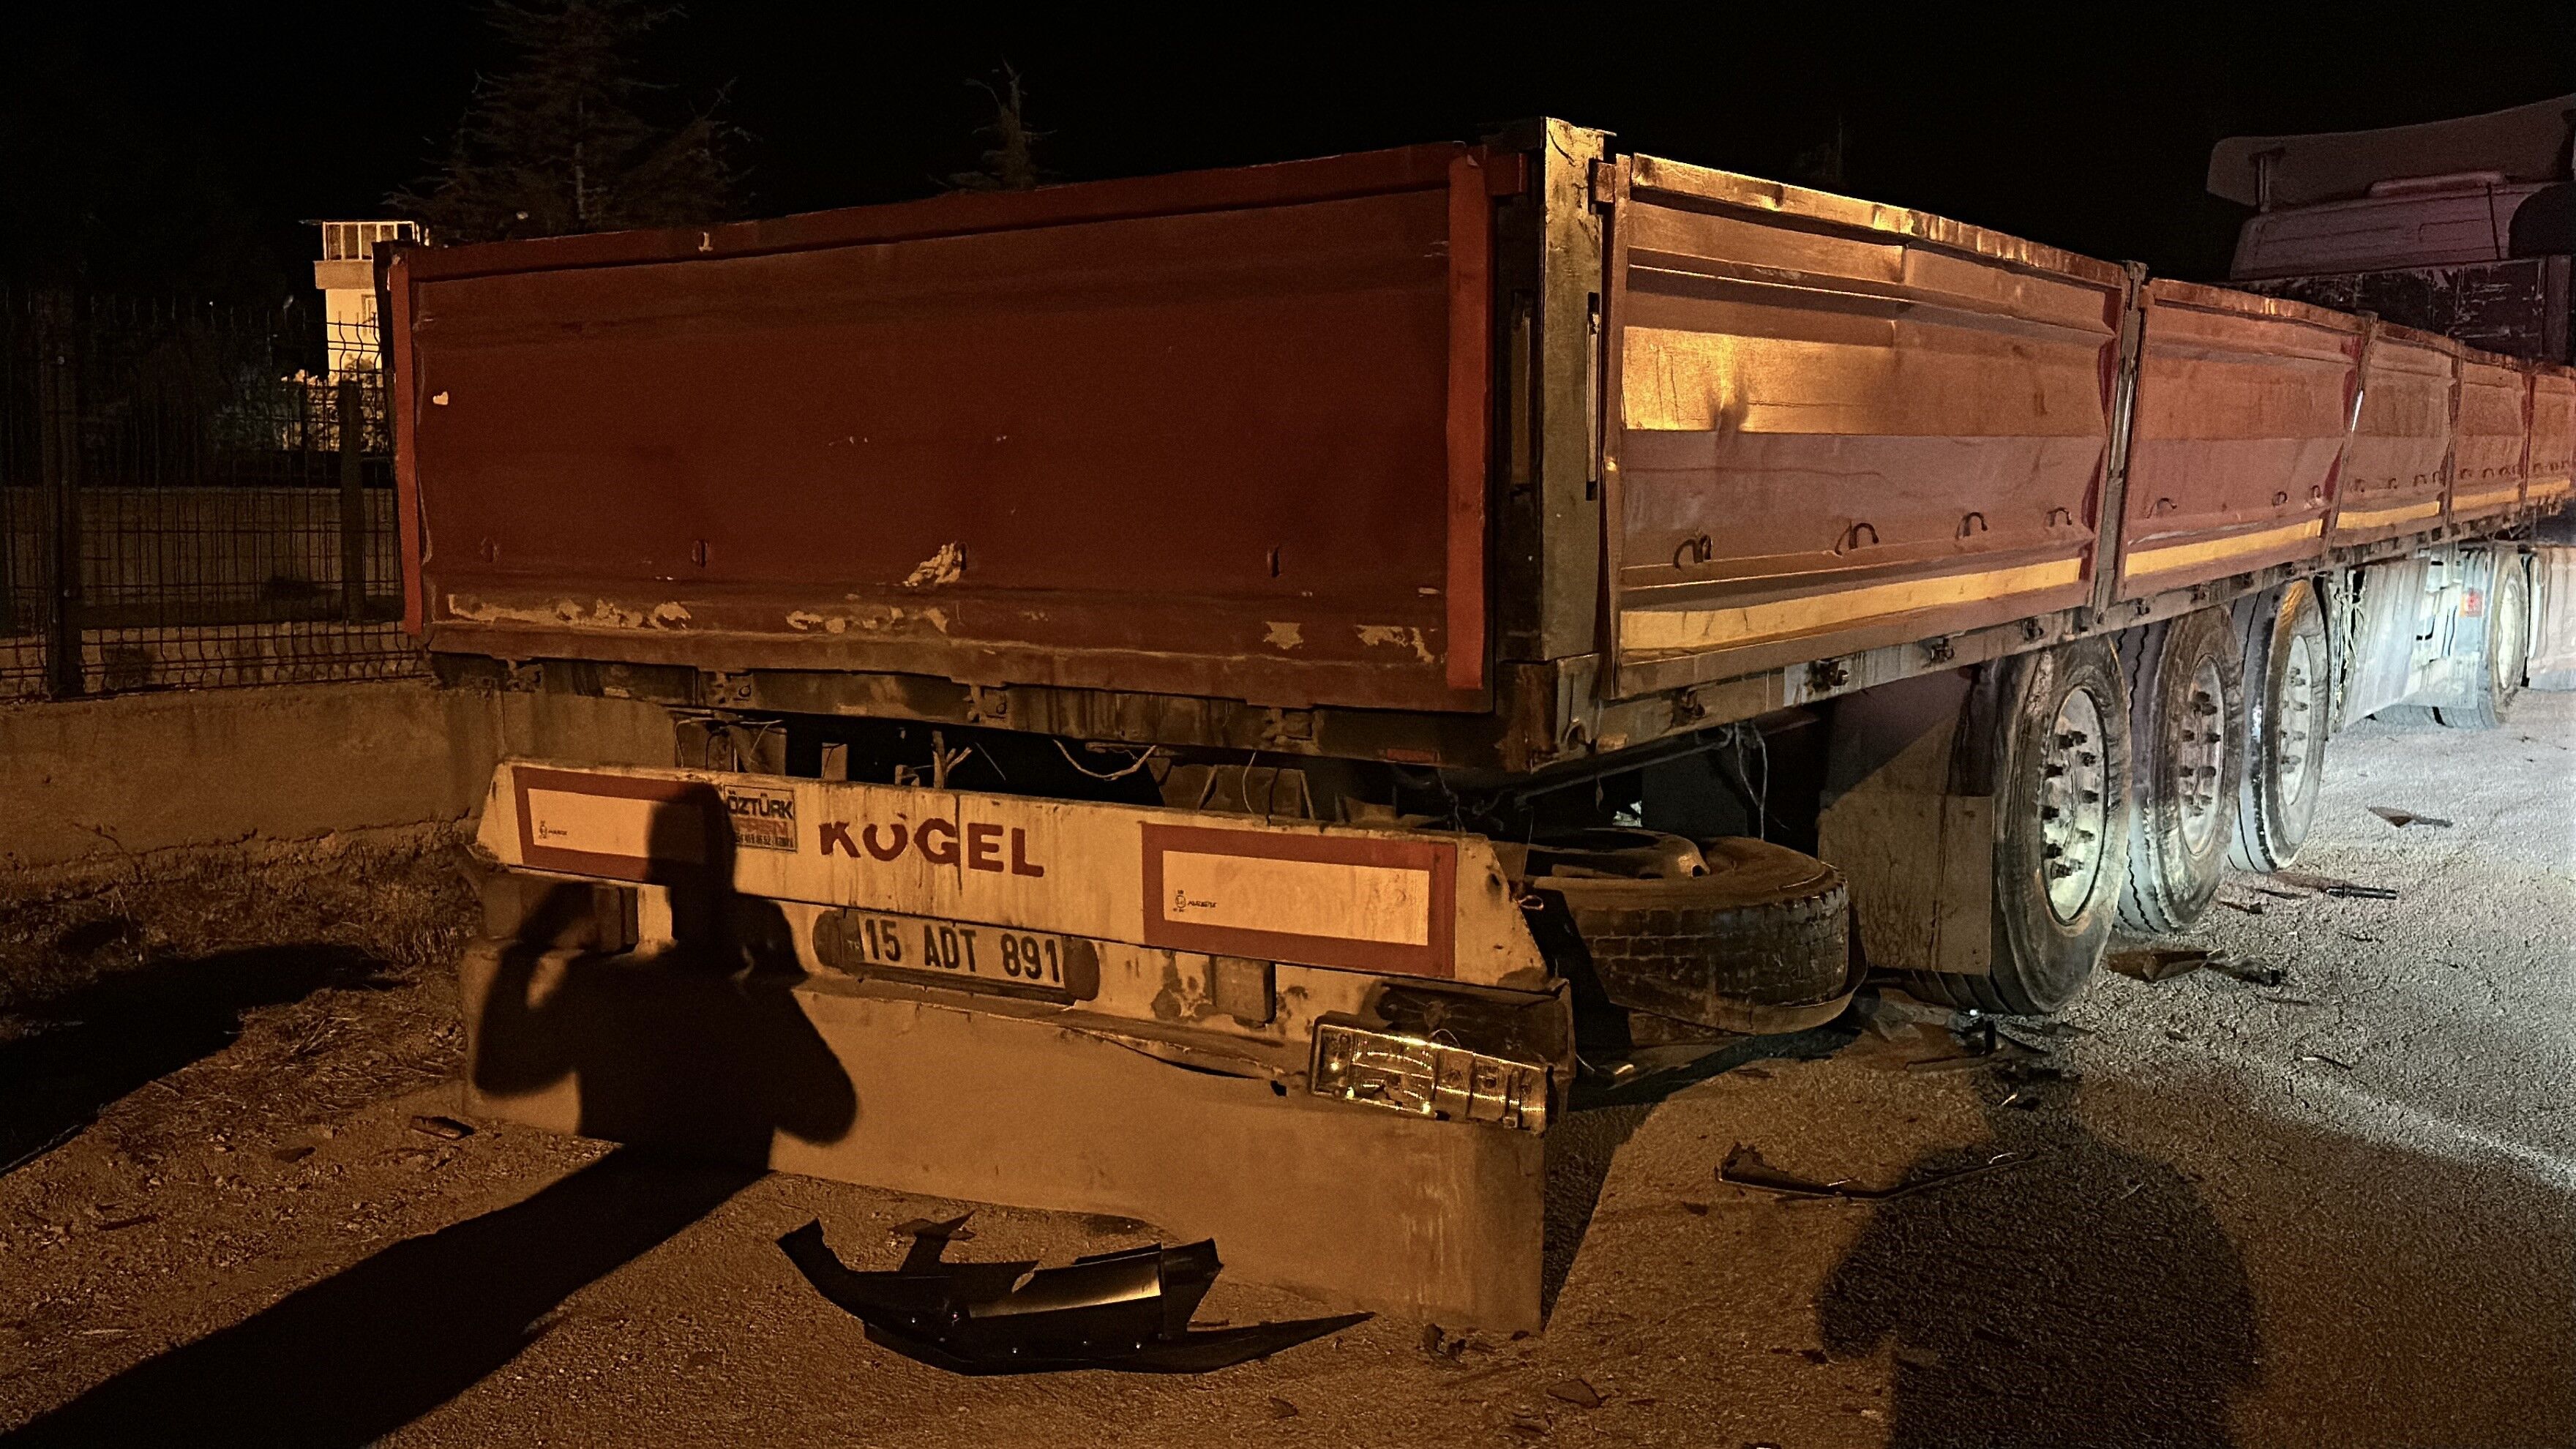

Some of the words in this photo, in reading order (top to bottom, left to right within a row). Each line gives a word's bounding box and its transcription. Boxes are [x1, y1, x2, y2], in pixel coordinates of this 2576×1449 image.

[727, 790, 793, 820] ÖZTÜRK
[865, 919, 901, 962] 15
[924, 925, 977, 973] ADT
[1000, 933, 1060, 983] 891
